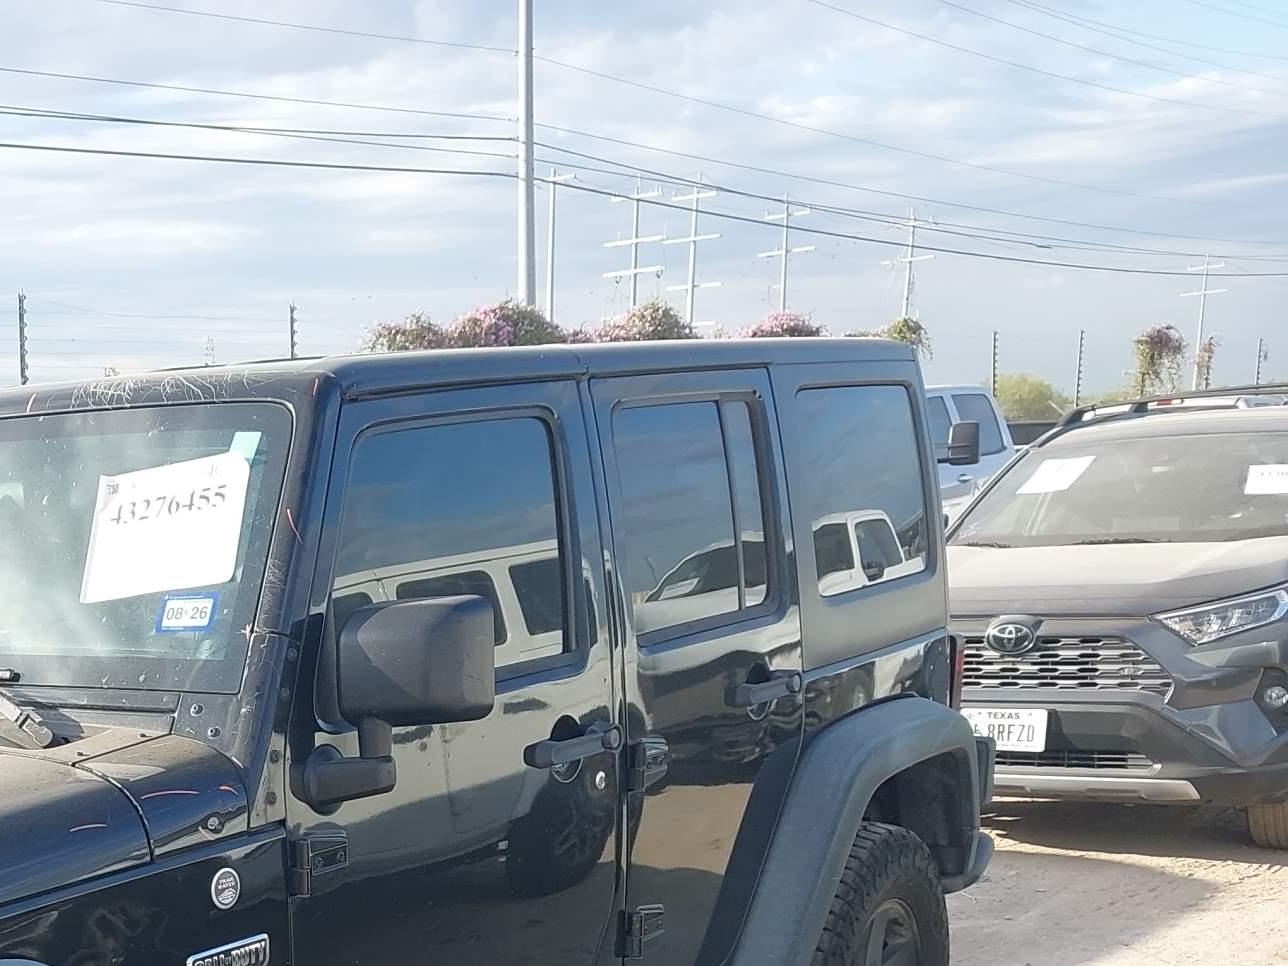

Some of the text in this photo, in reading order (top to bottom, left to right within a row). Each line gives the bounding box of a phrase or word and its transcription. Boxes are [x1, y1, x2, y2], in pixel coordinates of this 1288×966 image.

[110, 484, 227, 525] 43276455
[166, 606, 208, 621] 08 26
[987, 712, 1020, 720] TEXAS
